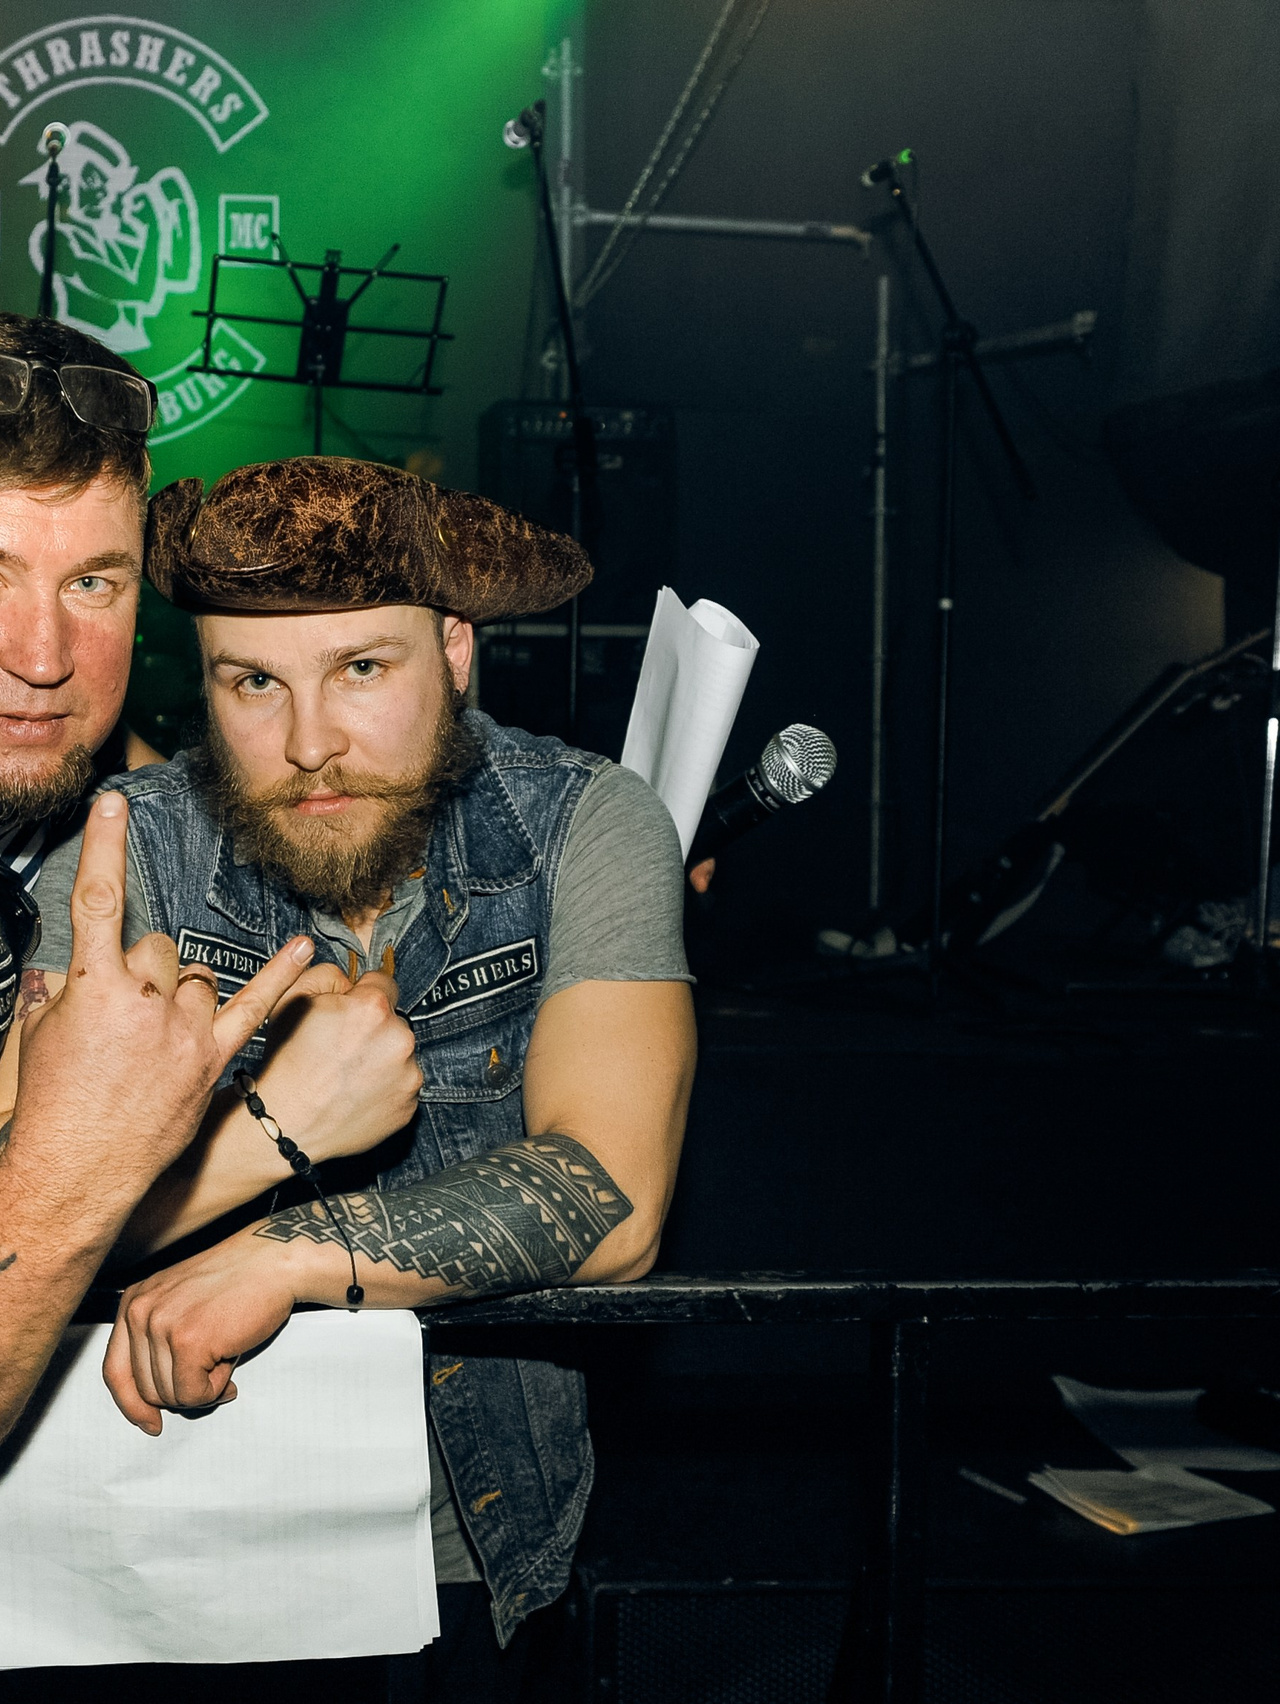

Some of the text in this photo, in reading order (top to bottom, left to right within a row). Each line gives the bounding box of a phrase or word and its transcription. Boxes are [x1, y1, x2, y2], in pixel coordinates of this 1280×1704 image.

[228, 212, 270, 250] MC
[182, 941, 267, 976] EKATERI
[421, 952, 532, 1006] RASHERS
